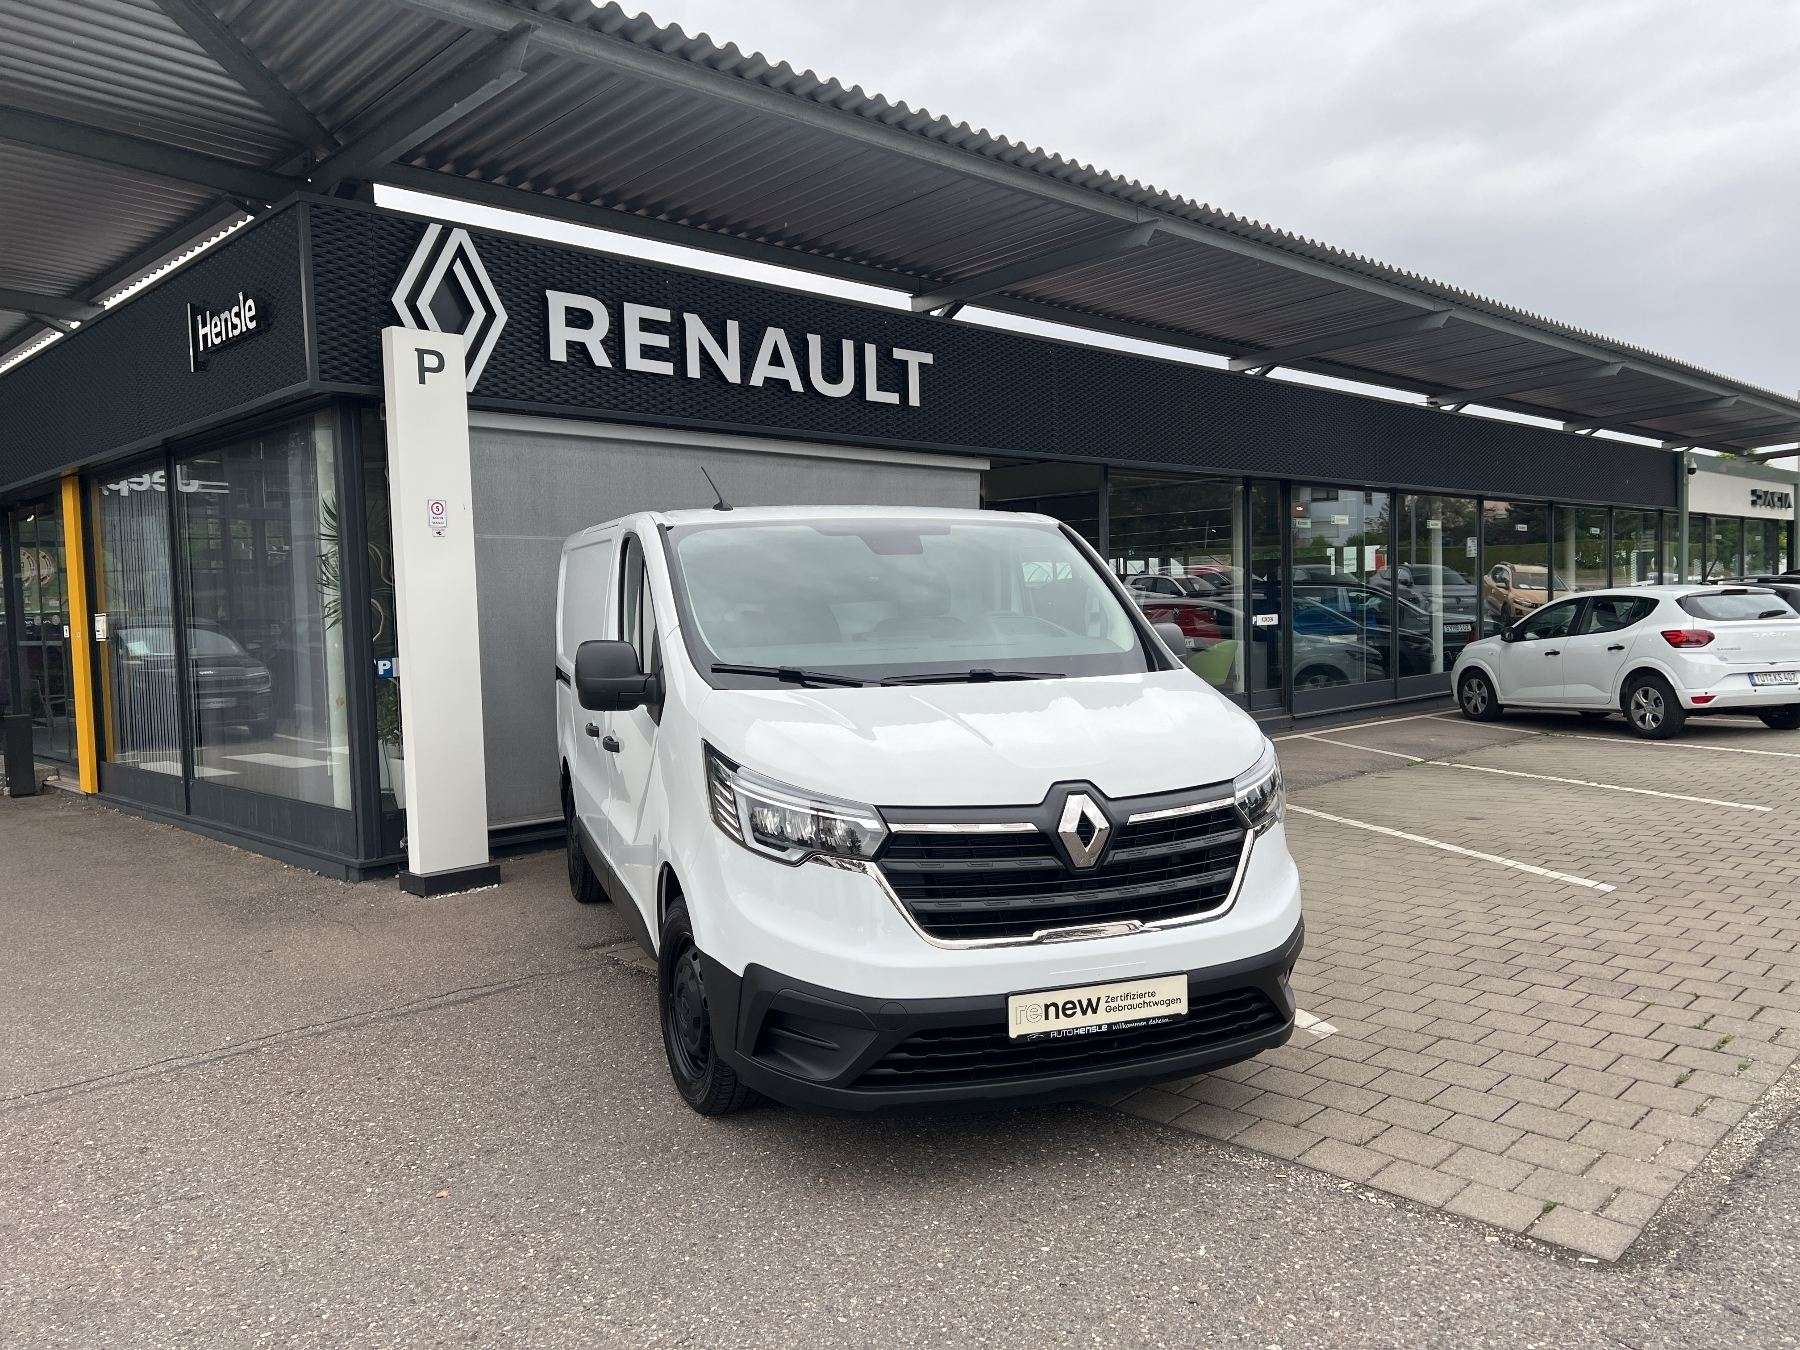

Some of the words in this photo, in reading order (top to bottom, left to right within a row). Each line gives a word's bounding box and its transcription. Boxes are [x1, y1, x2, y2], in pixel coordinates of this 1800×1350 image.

[197, 291, 257, 352] Hensle
[545, 288, 935, 407] RENAULT
[416, 346, 445, 386] P
[377, 660, 391, 675] P
[1015, 997, 1101, 1025] renew
[1104, 990, 1157, 1004] Zertifizierte
[1105, 997, 1182, 1013] Gebrauchtwagen
